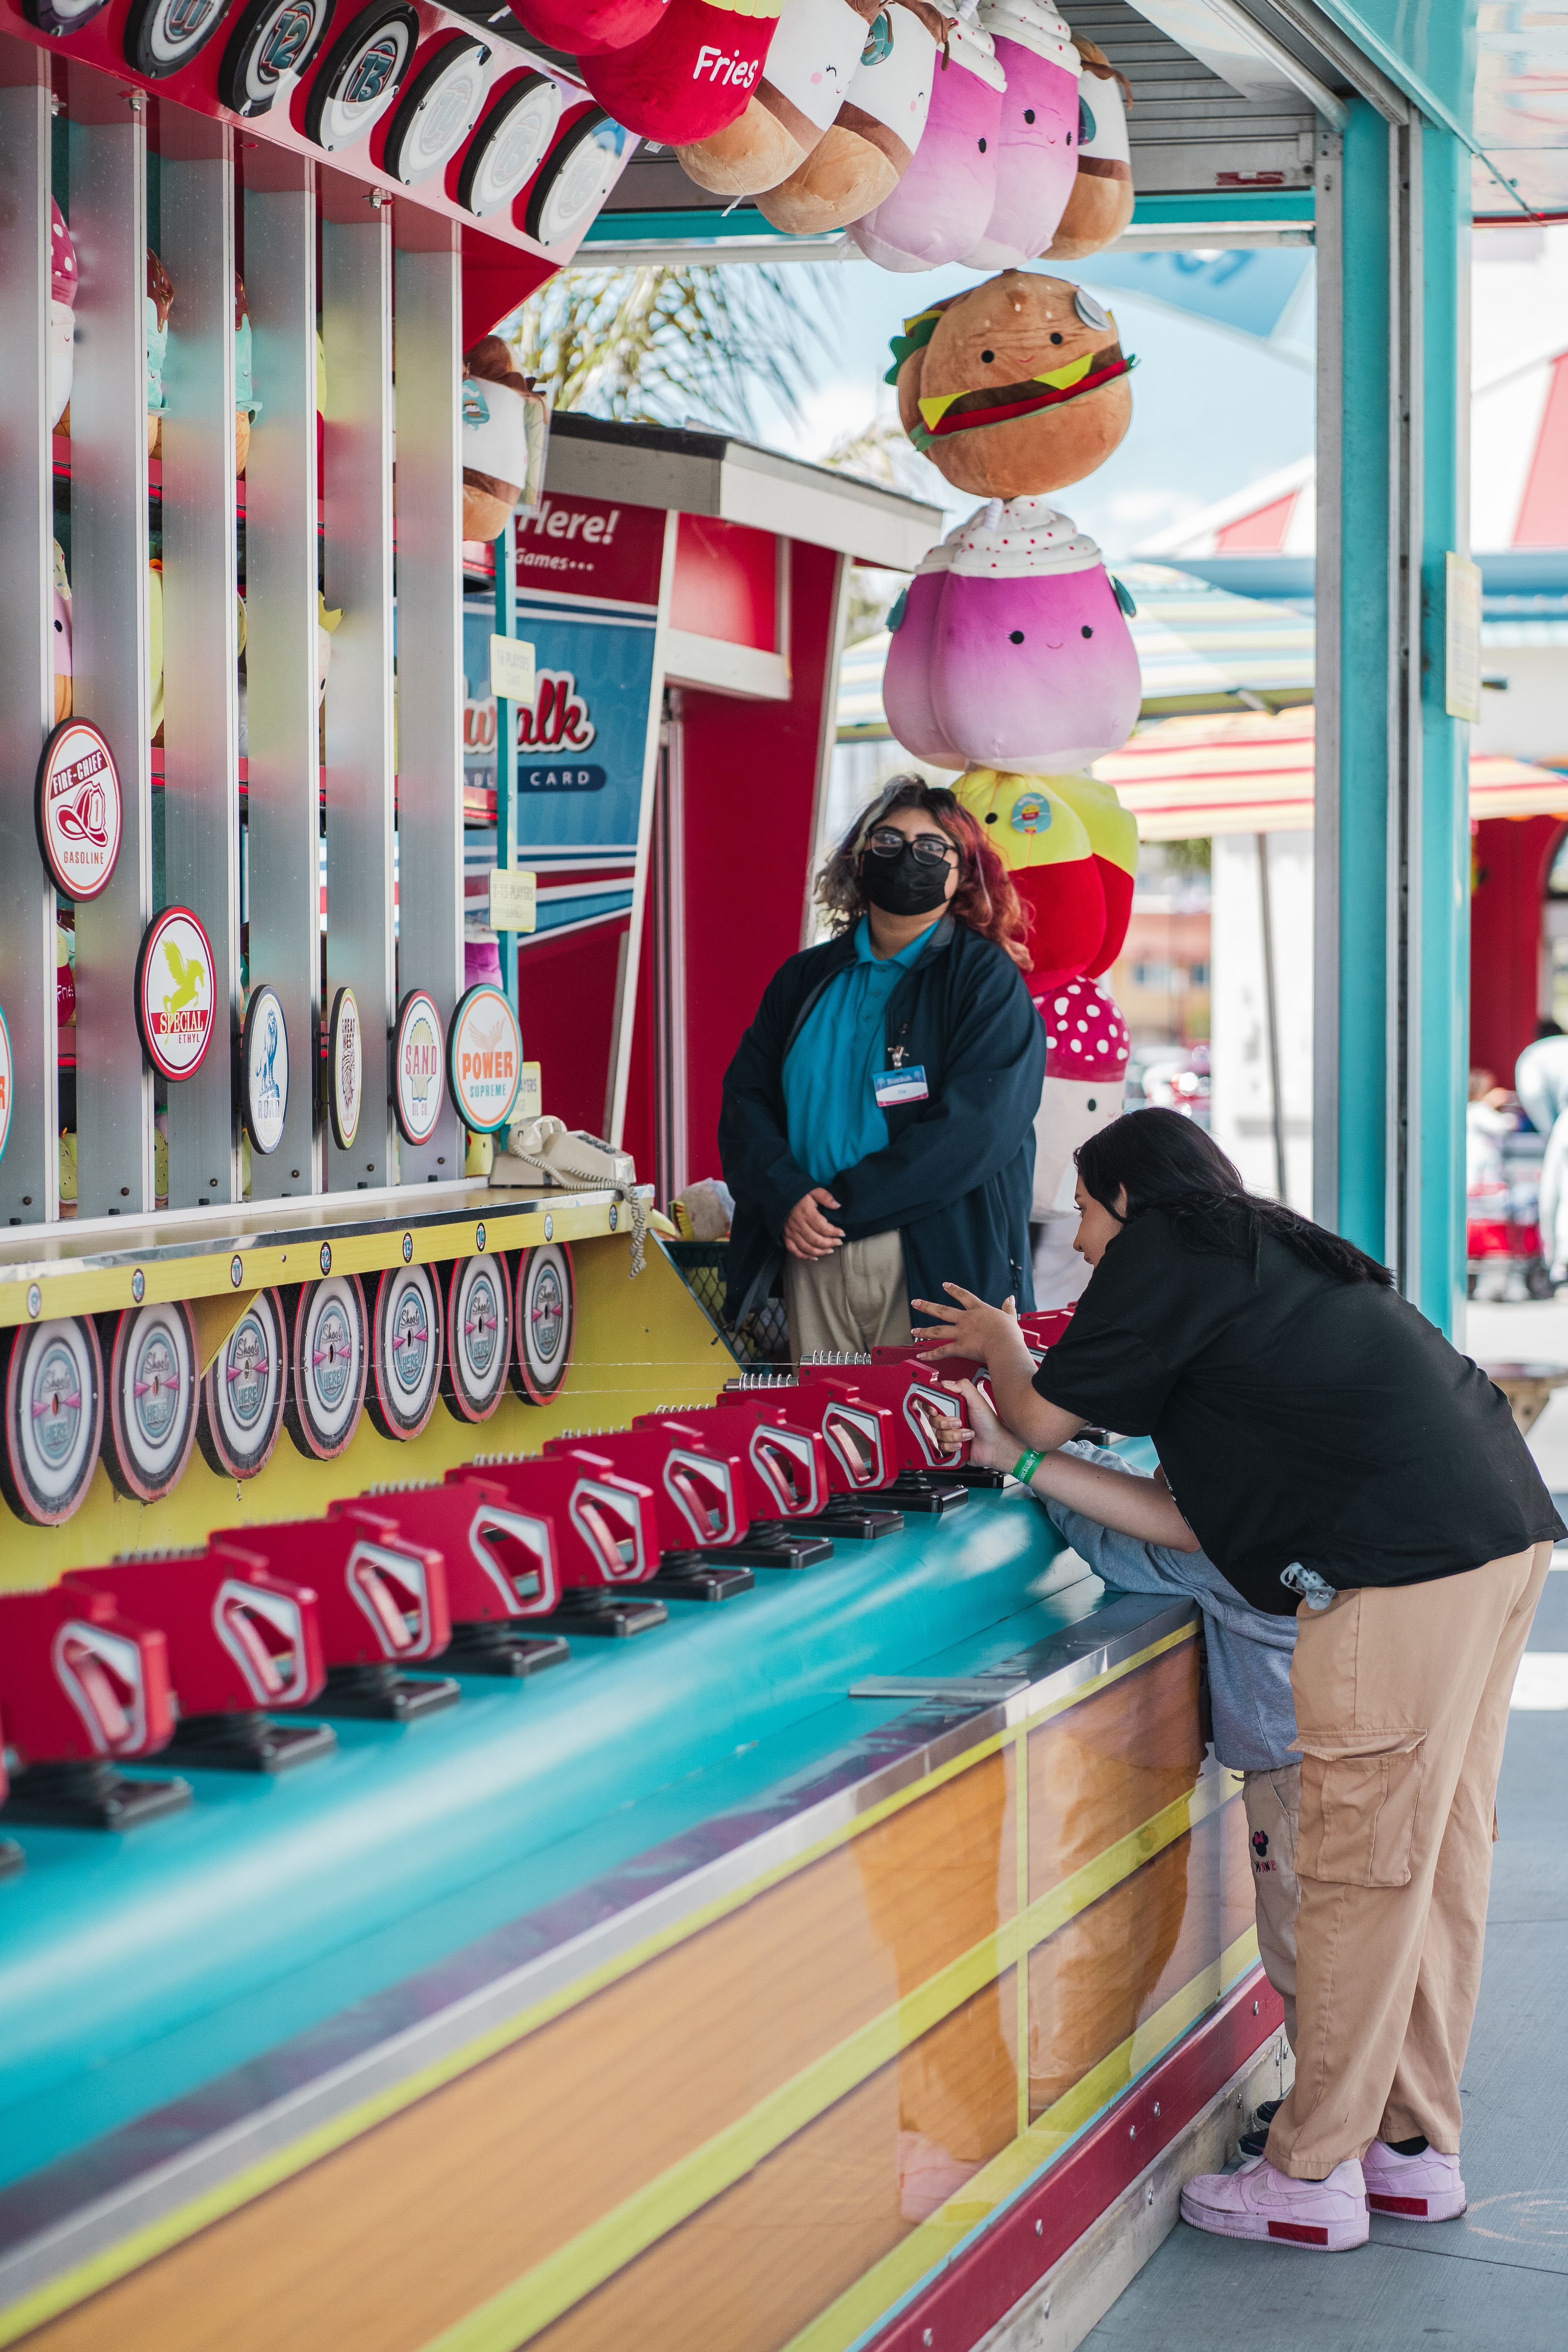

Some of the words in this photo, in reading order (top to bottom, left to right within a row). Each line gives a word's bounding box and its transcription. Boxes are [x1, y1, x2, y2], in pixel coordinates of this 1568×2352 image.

[261, 8, 310, 72] 12
[693, 45, 759, 88] Fries
[346, 49, 395, 109] 13
[424, 88, 468, 143] 14
[494, 122, 539, 176] 15
[513, 499, 621, 545] Here!
[53, 751, 103, 795] FIRE-CHIEF
[530, 771, 590, 786] CARD
[64, 851, 104, 864] GASOLINE
[160, 1011, 203, 1034] SPECIAL
[341, 1018, 355, 1033] GREAT
[178, 1033, 200, 1044] ETHYL
[405, 1044, 437, 1075] SAND
[462, 1050, 513, 1080] POWER
[470, 1083, 506, 1098] SUPREME
[258, 1099, 279, 1119] ROAR
[404, 1239, 412, 1258] 13
[321, 1249, 330, 1269] 12
[472, 1297, 490, 1315] Shoot
[401, 1308, 419, 1328] Shoot
[322, 1323, 343, 1342] Shoot
[236, 1337, 259, 1357] Shoot
[402, 1352, 418, 1372] HERE
[324, 1368, 341, 1389] HERE
[238, 1384, 258, 1407] HERE
[1255, 1860, 1277, 1873] MINNIE
